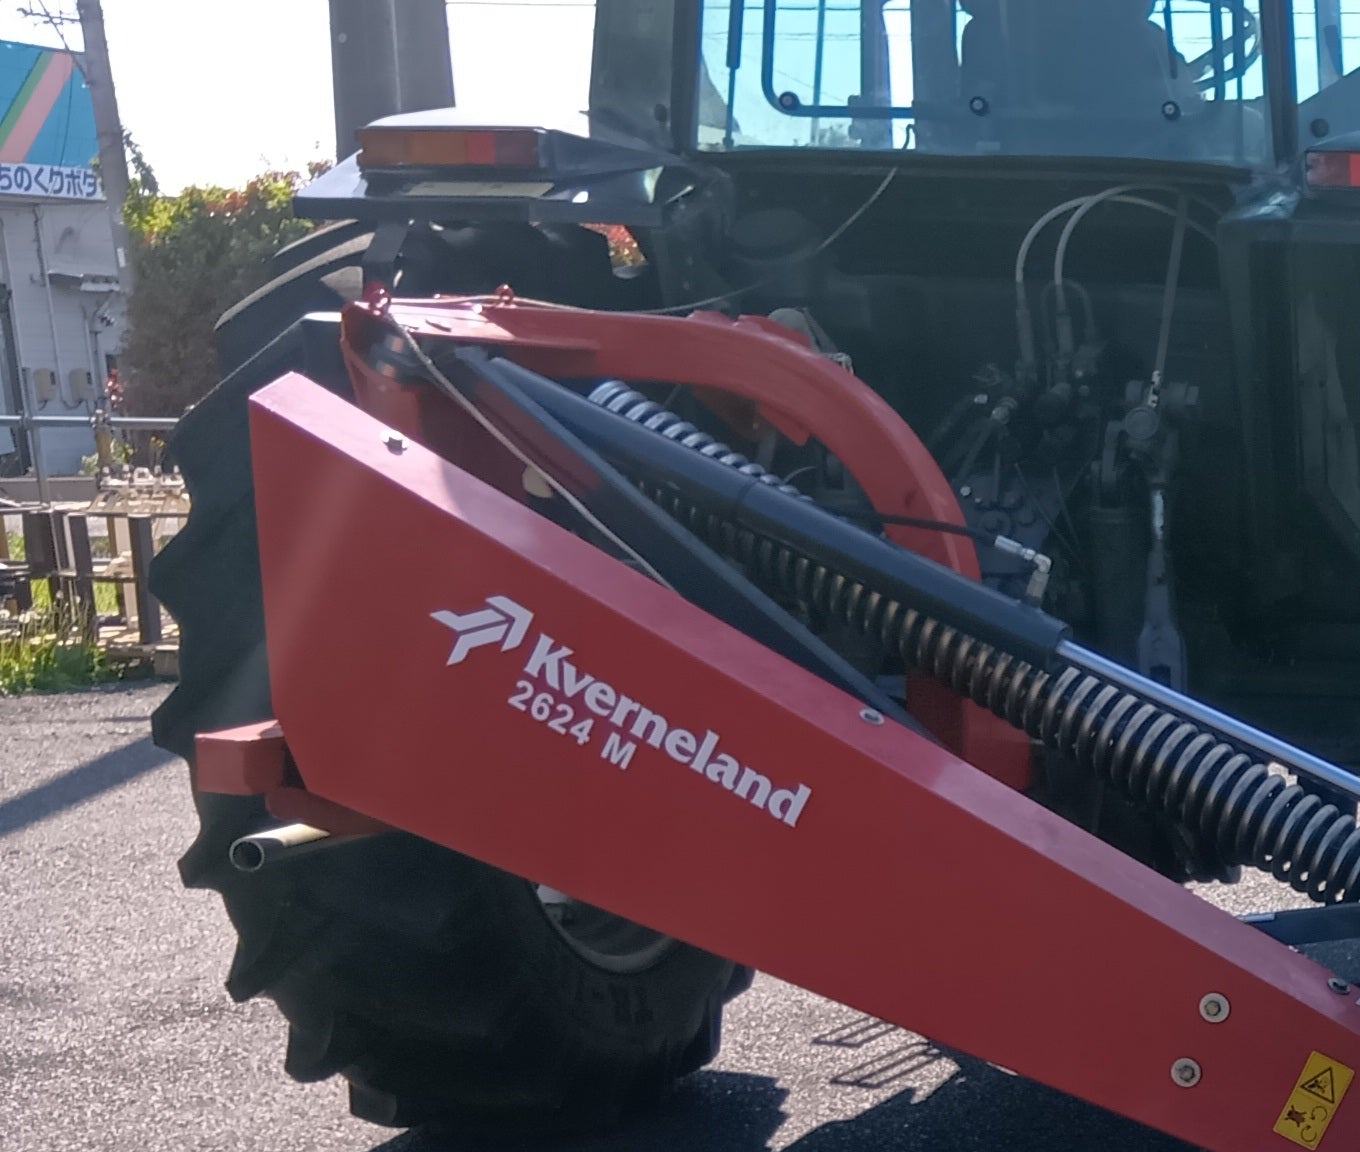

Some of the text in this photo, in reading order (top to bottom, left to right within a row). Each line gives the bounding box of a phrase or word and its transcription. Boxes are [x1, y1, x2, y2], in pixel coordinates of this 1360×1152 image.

[507, 680, 637, 769] 2624 M
[524, 633, 811, 827] Kverneland
